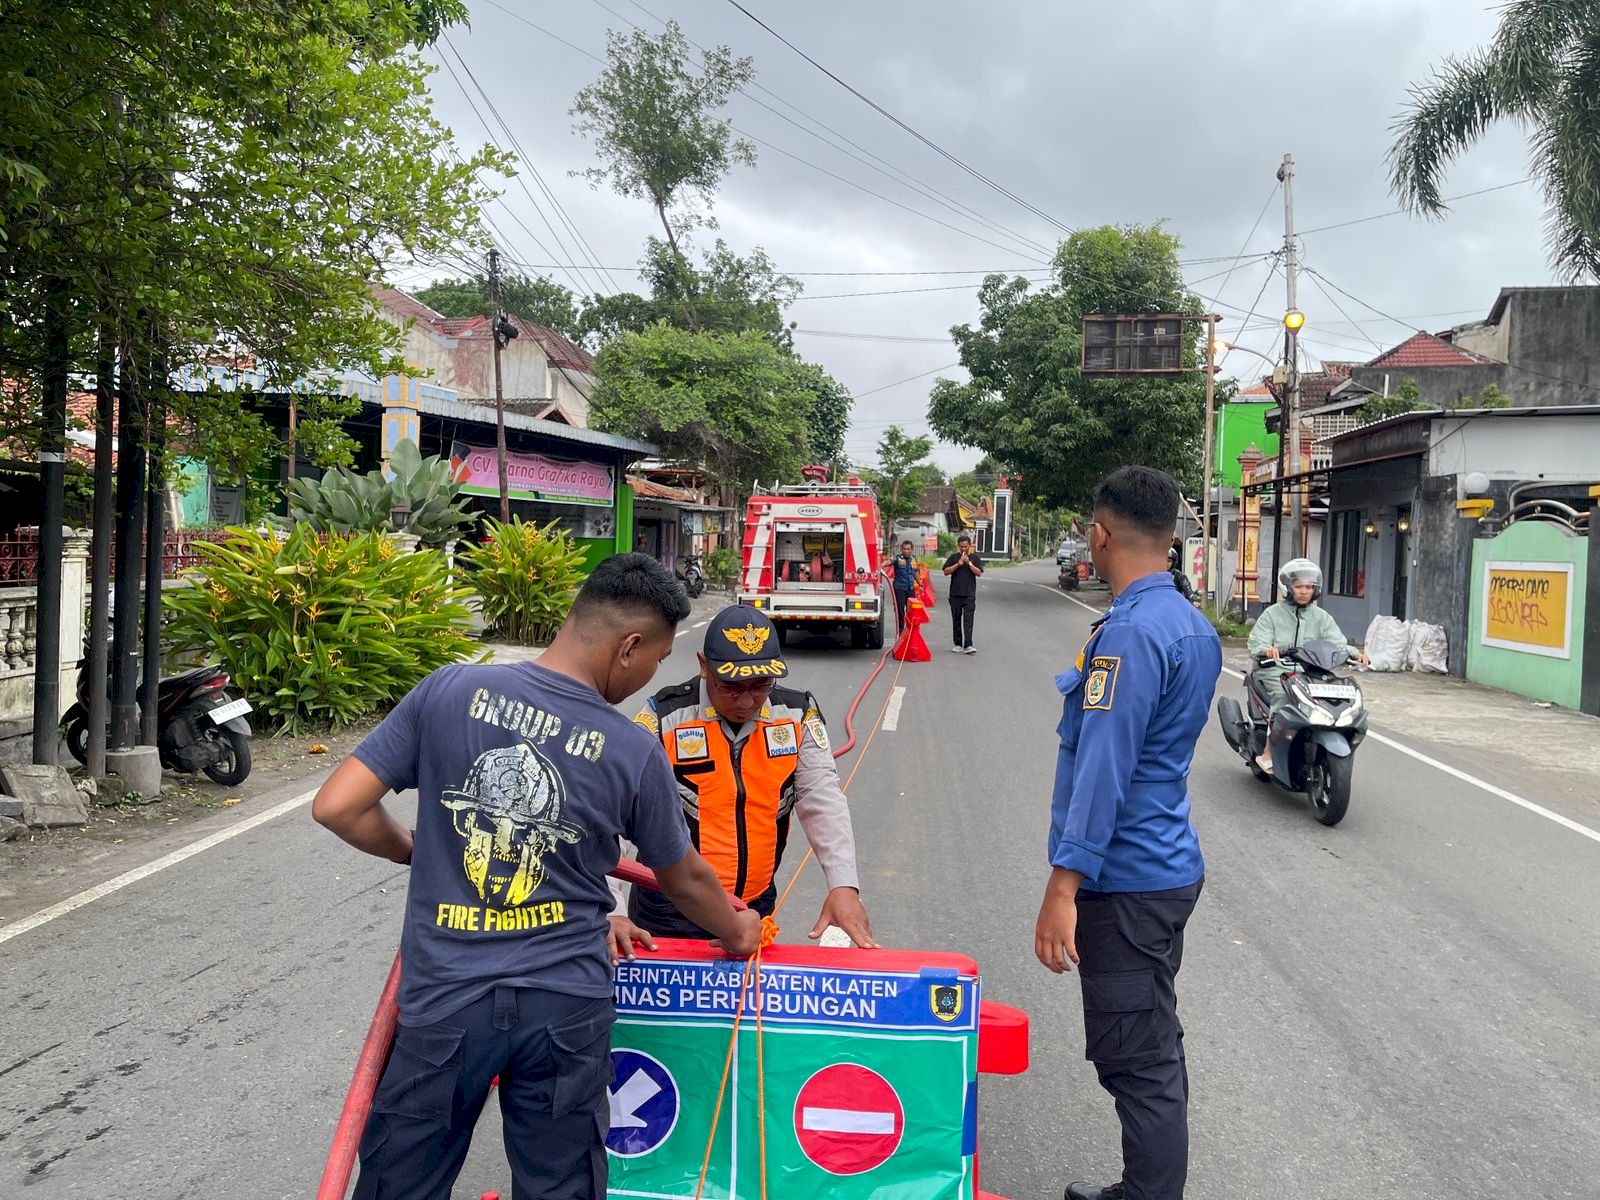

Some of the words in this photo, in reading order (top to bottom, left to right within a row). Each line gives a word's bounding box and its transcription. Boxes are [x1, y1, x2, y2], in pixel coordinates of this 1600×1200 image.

[472, 456, 493, 473] CV.
[505, 460, 535, 478] arna
[538, 465, 577, 484] Grafika
[580, 471, 605, 489] Raya
[716, 659, 786, 678] DISHUB
[468, 687, 563, 745] GROUP
[565, 725, 605, 762] 03
[678, 730, 704, 740] DISHUB
[770, 746, 797, 756] DISHUB
[436, 903, 480, 931] FIRE
[483, 901, 565, 931] FIGHTER
[612, 966, 696, 986] ERINTAH
[701, 971, 815, 992] KABUPATEN
[821, 977, 897, 998] KLATEN
[614, 985, 670, 1007] INAS
[679, 989, 876, 1019] PERHUBUNGAN
